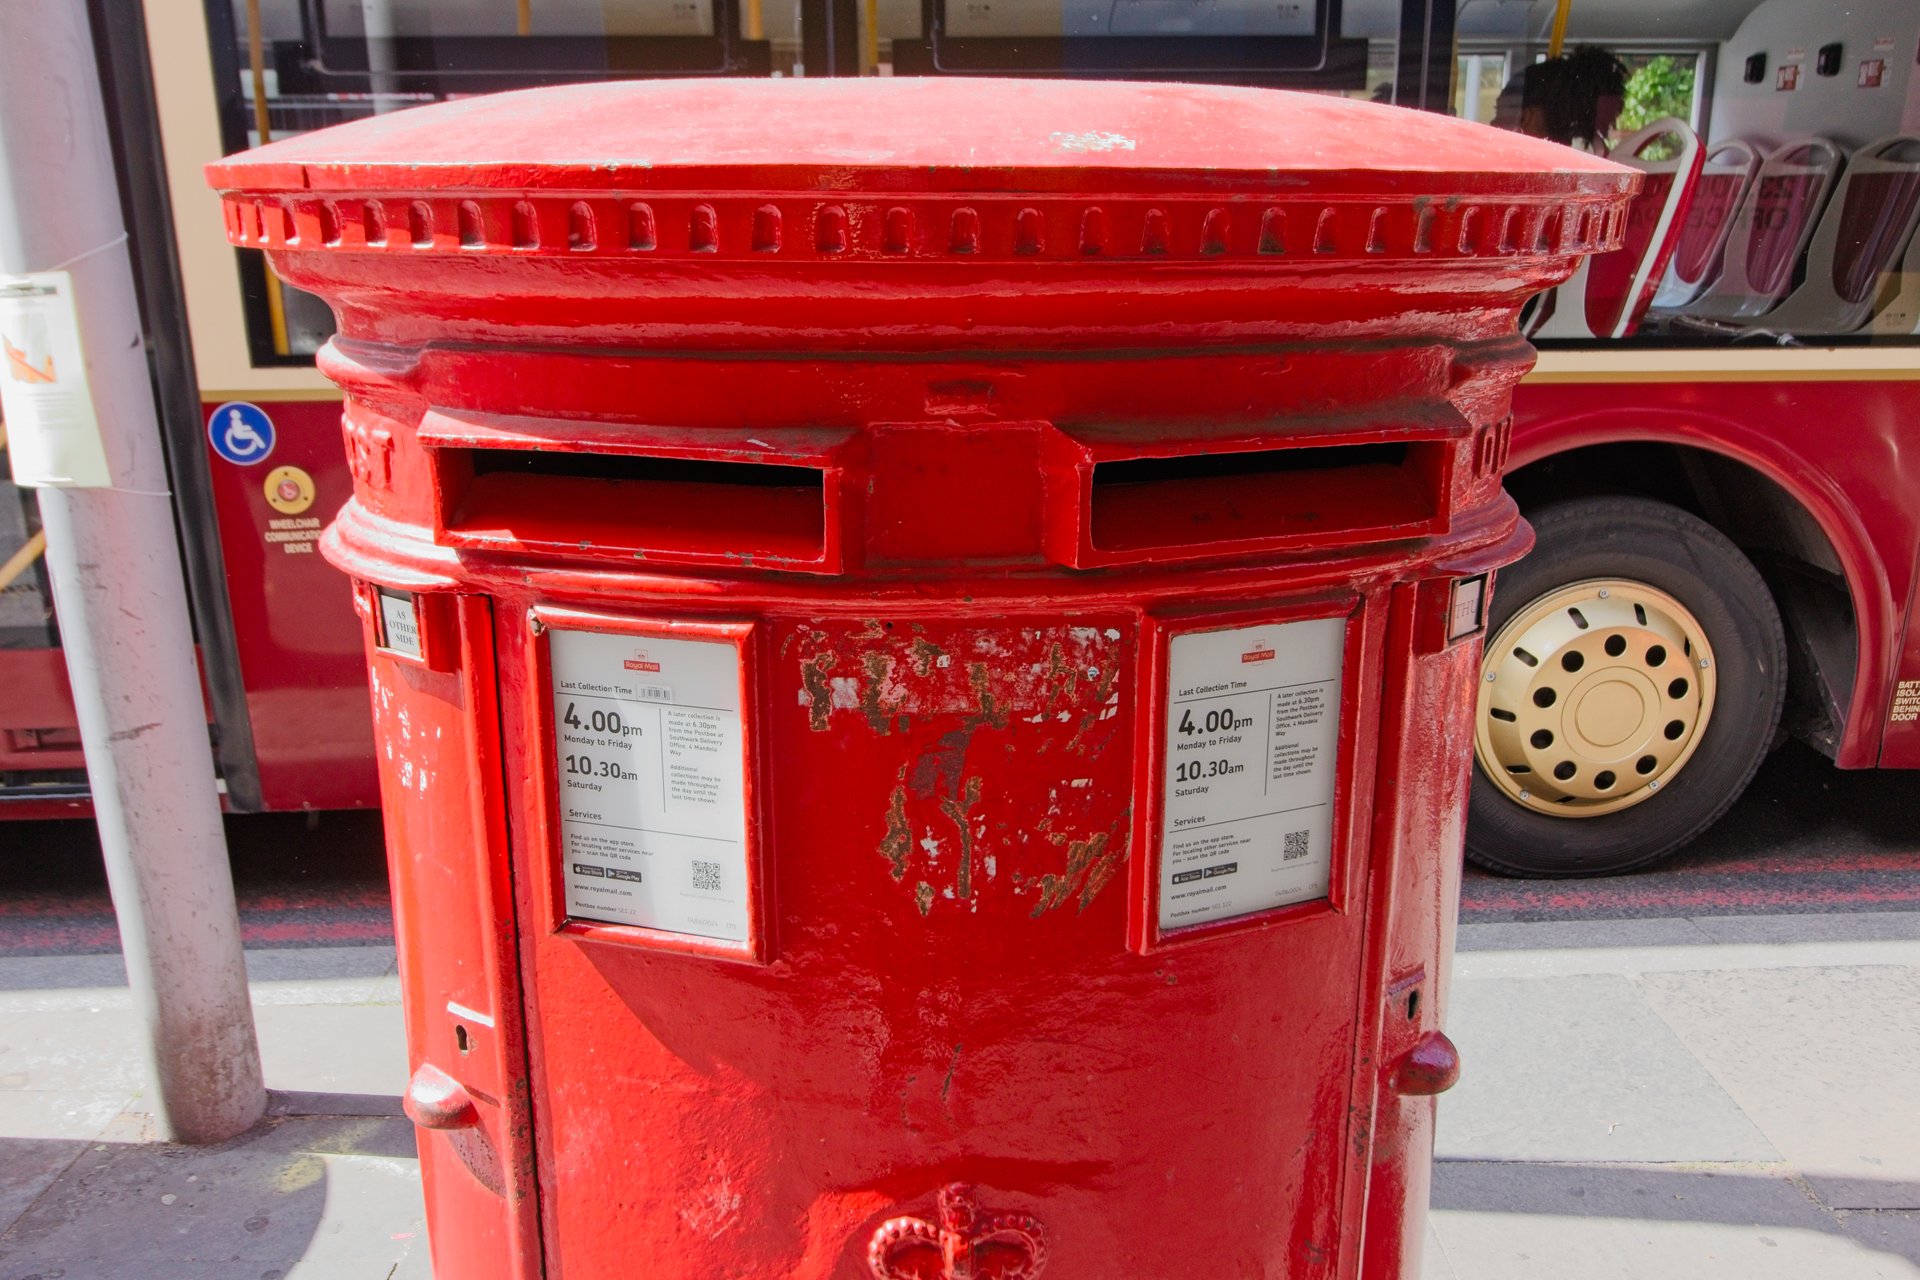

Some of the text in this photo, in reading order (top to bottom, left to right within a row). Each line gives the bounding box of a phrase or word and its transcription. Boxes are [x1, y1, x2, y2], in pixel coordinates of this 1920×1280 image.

[268, 518, 321, 530] WHEELCHAIR
[284, 543, 313, 554] DEVICE
[396, 610, 407, 620] AS
[389, 620, 417, 635] OTHER
[395, 633, 415, 646] SIDE
[1243, 651, 1274, 661] Royal Mail
[625, 661, 659, 671] Royal Mail
[560, 680, 633, 694] Last Collection Time
[1179, 680, 1247, 697] Last Collection Time
[1898, 681, 1920, 689] BATT
[1893, 705, 1920, 713] BEHIN
[563, 702, 643, 737] 4.00pm
[1178, 708, 1253, 736] 4.00pm
[1276, 711, 1323, 723] Southwark Delivery
[1297, 718, 1318, 726] Mandela
[1891, 713, 1918, 721] DOOR
[692, 721, 717, 730] 6.30pm
[564, 735, 595, 747] Monday
[607, 739, 633, 750] Friday
[669, 734, 723, 746] Southwark Delivery
[1177, 740, 1207, 752] Monday
[1219, 735, 1242, 746] Friday
[1275, 742, 1299, 750] Additional
[1274, 750, 1299, 758] collections
[1288, 754, 1315, 763] throughout
[566, 754, 638, 781] 10.30am
[670, 764, 698, 772] Additional
[1176, 759, 1244, 783] 10.30am
[671, 772, 699, 780] collections
[567, 780, 603, 792] Saturday
[688, 781, 719, 789] throughout
[1175, 785, 1209, 797] Saturday
[569, 809, 602, 820] Services
[1173, 814, 1205, 827] Services
[581, 842, 602, 850] locating
[1182, 847, 1203, 855] locating
[574, 884, 633, 896] www.royalmail.com
[1171, 884, 1227, 900] www.royalmail.com
[575, 901, 595, 909] Postbox
[1191, 905, 1210, 914] number
